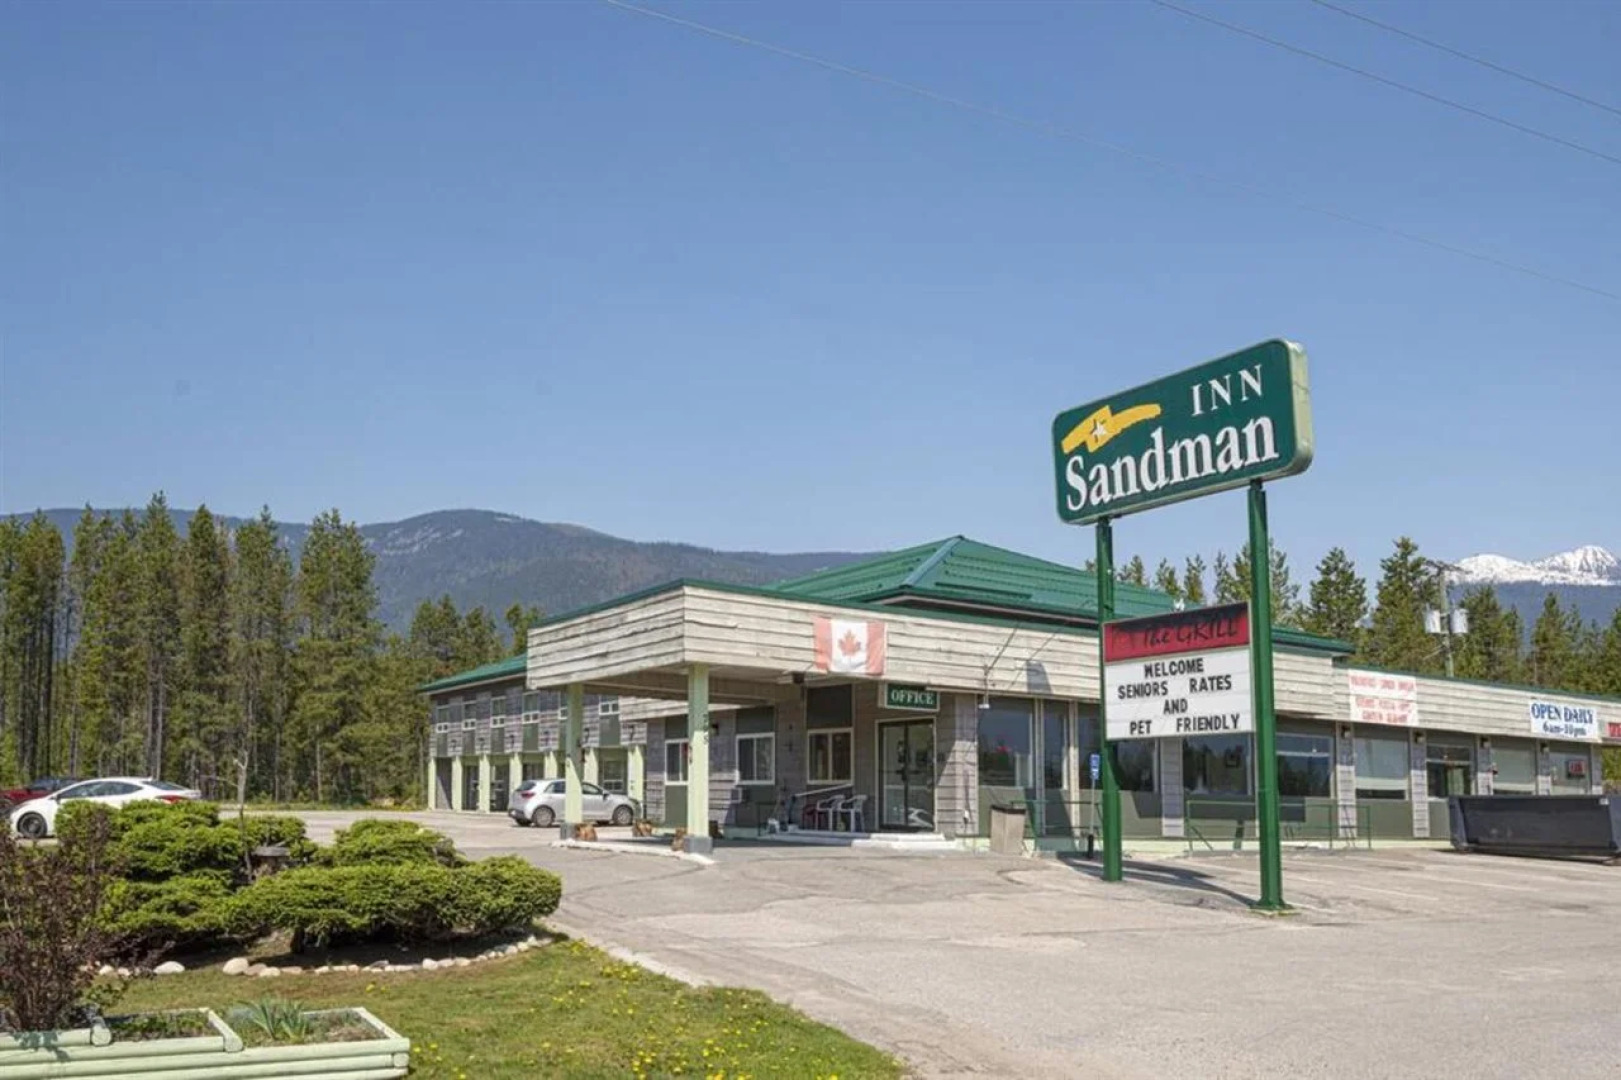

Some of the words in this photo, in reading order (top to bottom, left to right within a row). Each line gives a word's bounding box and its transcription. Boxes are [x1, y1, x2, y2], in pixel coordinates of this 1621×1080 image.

[1190, 364, 1263, 417] INN
[1064, 415, 1279, 512] Sandman
[1144, 658, 1204, 678] WELCOME
[890, 689, 935, 705] OFFICE
[1117, 680, 1168, 700] SENIORS
[1189, 674, 1232, 693] RATES
[1163, 699, 1188, 714] AND
[1531, 703, 1562, 720] OPEN
[1563, 706, 1593, 724] DAILY
[1129, 720, 1152, 735] PET
[1176, 713, 1240, 732] FRIENDLY
